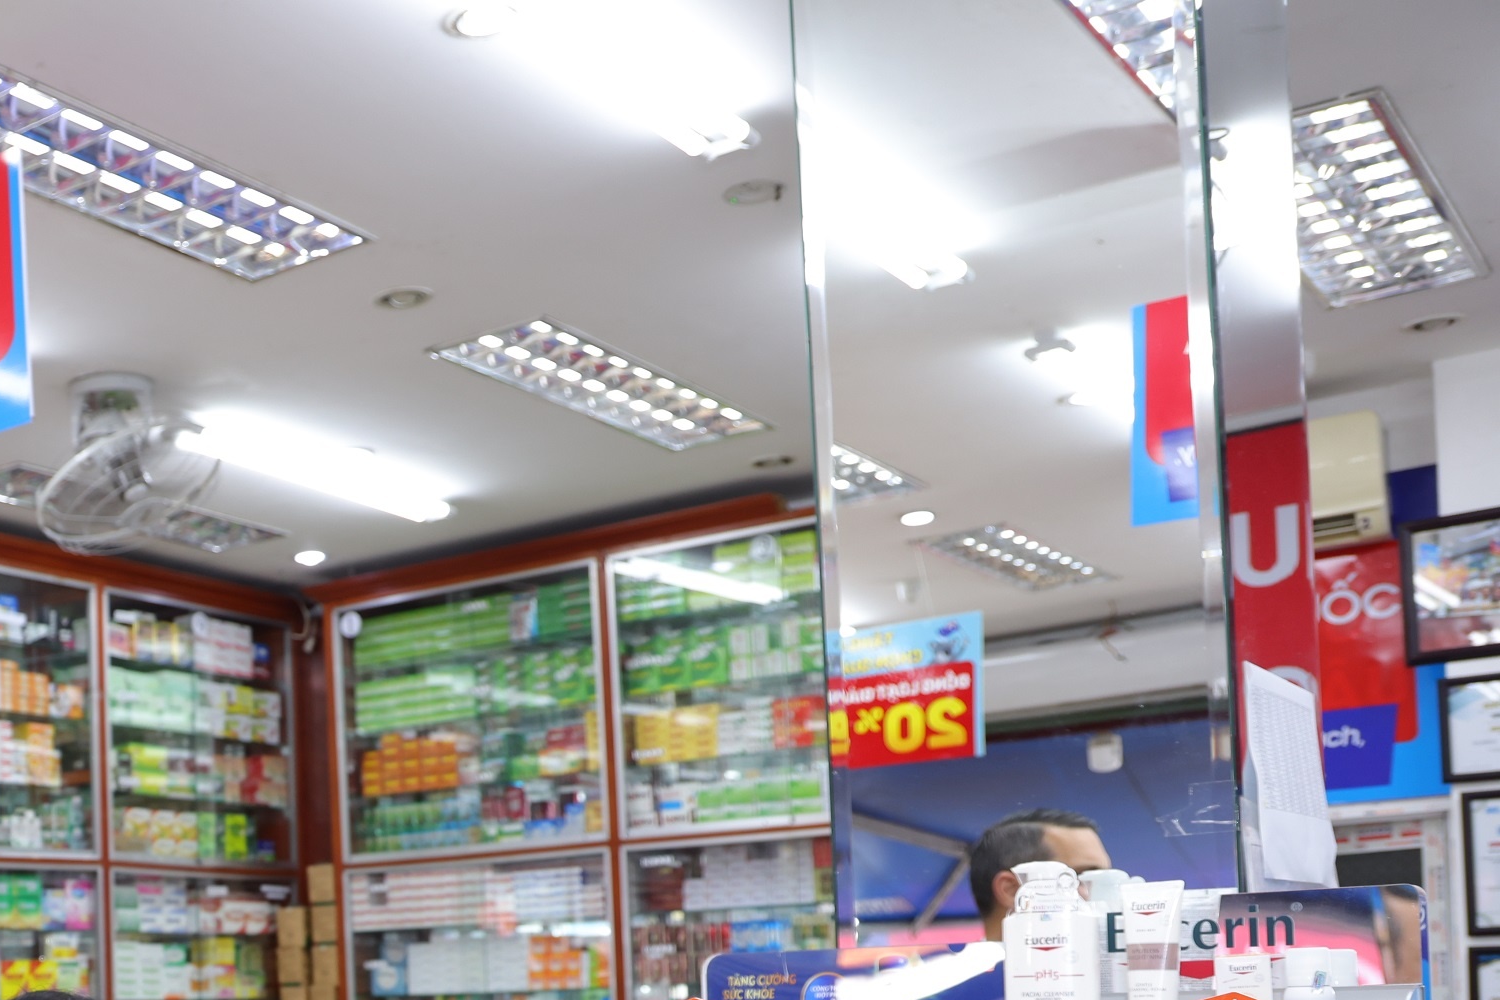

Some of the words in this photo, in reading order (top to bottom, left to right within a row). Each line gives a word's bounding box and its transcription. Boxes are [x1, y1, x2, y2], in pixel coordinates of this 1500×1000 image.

[1131, 901, 1166, 911] Eucerin
[1228, 963, 1258, 972] Eucerin
[728, 973, 756, 987] TĂNG
[1034, 969, 1060, 982] pH5
